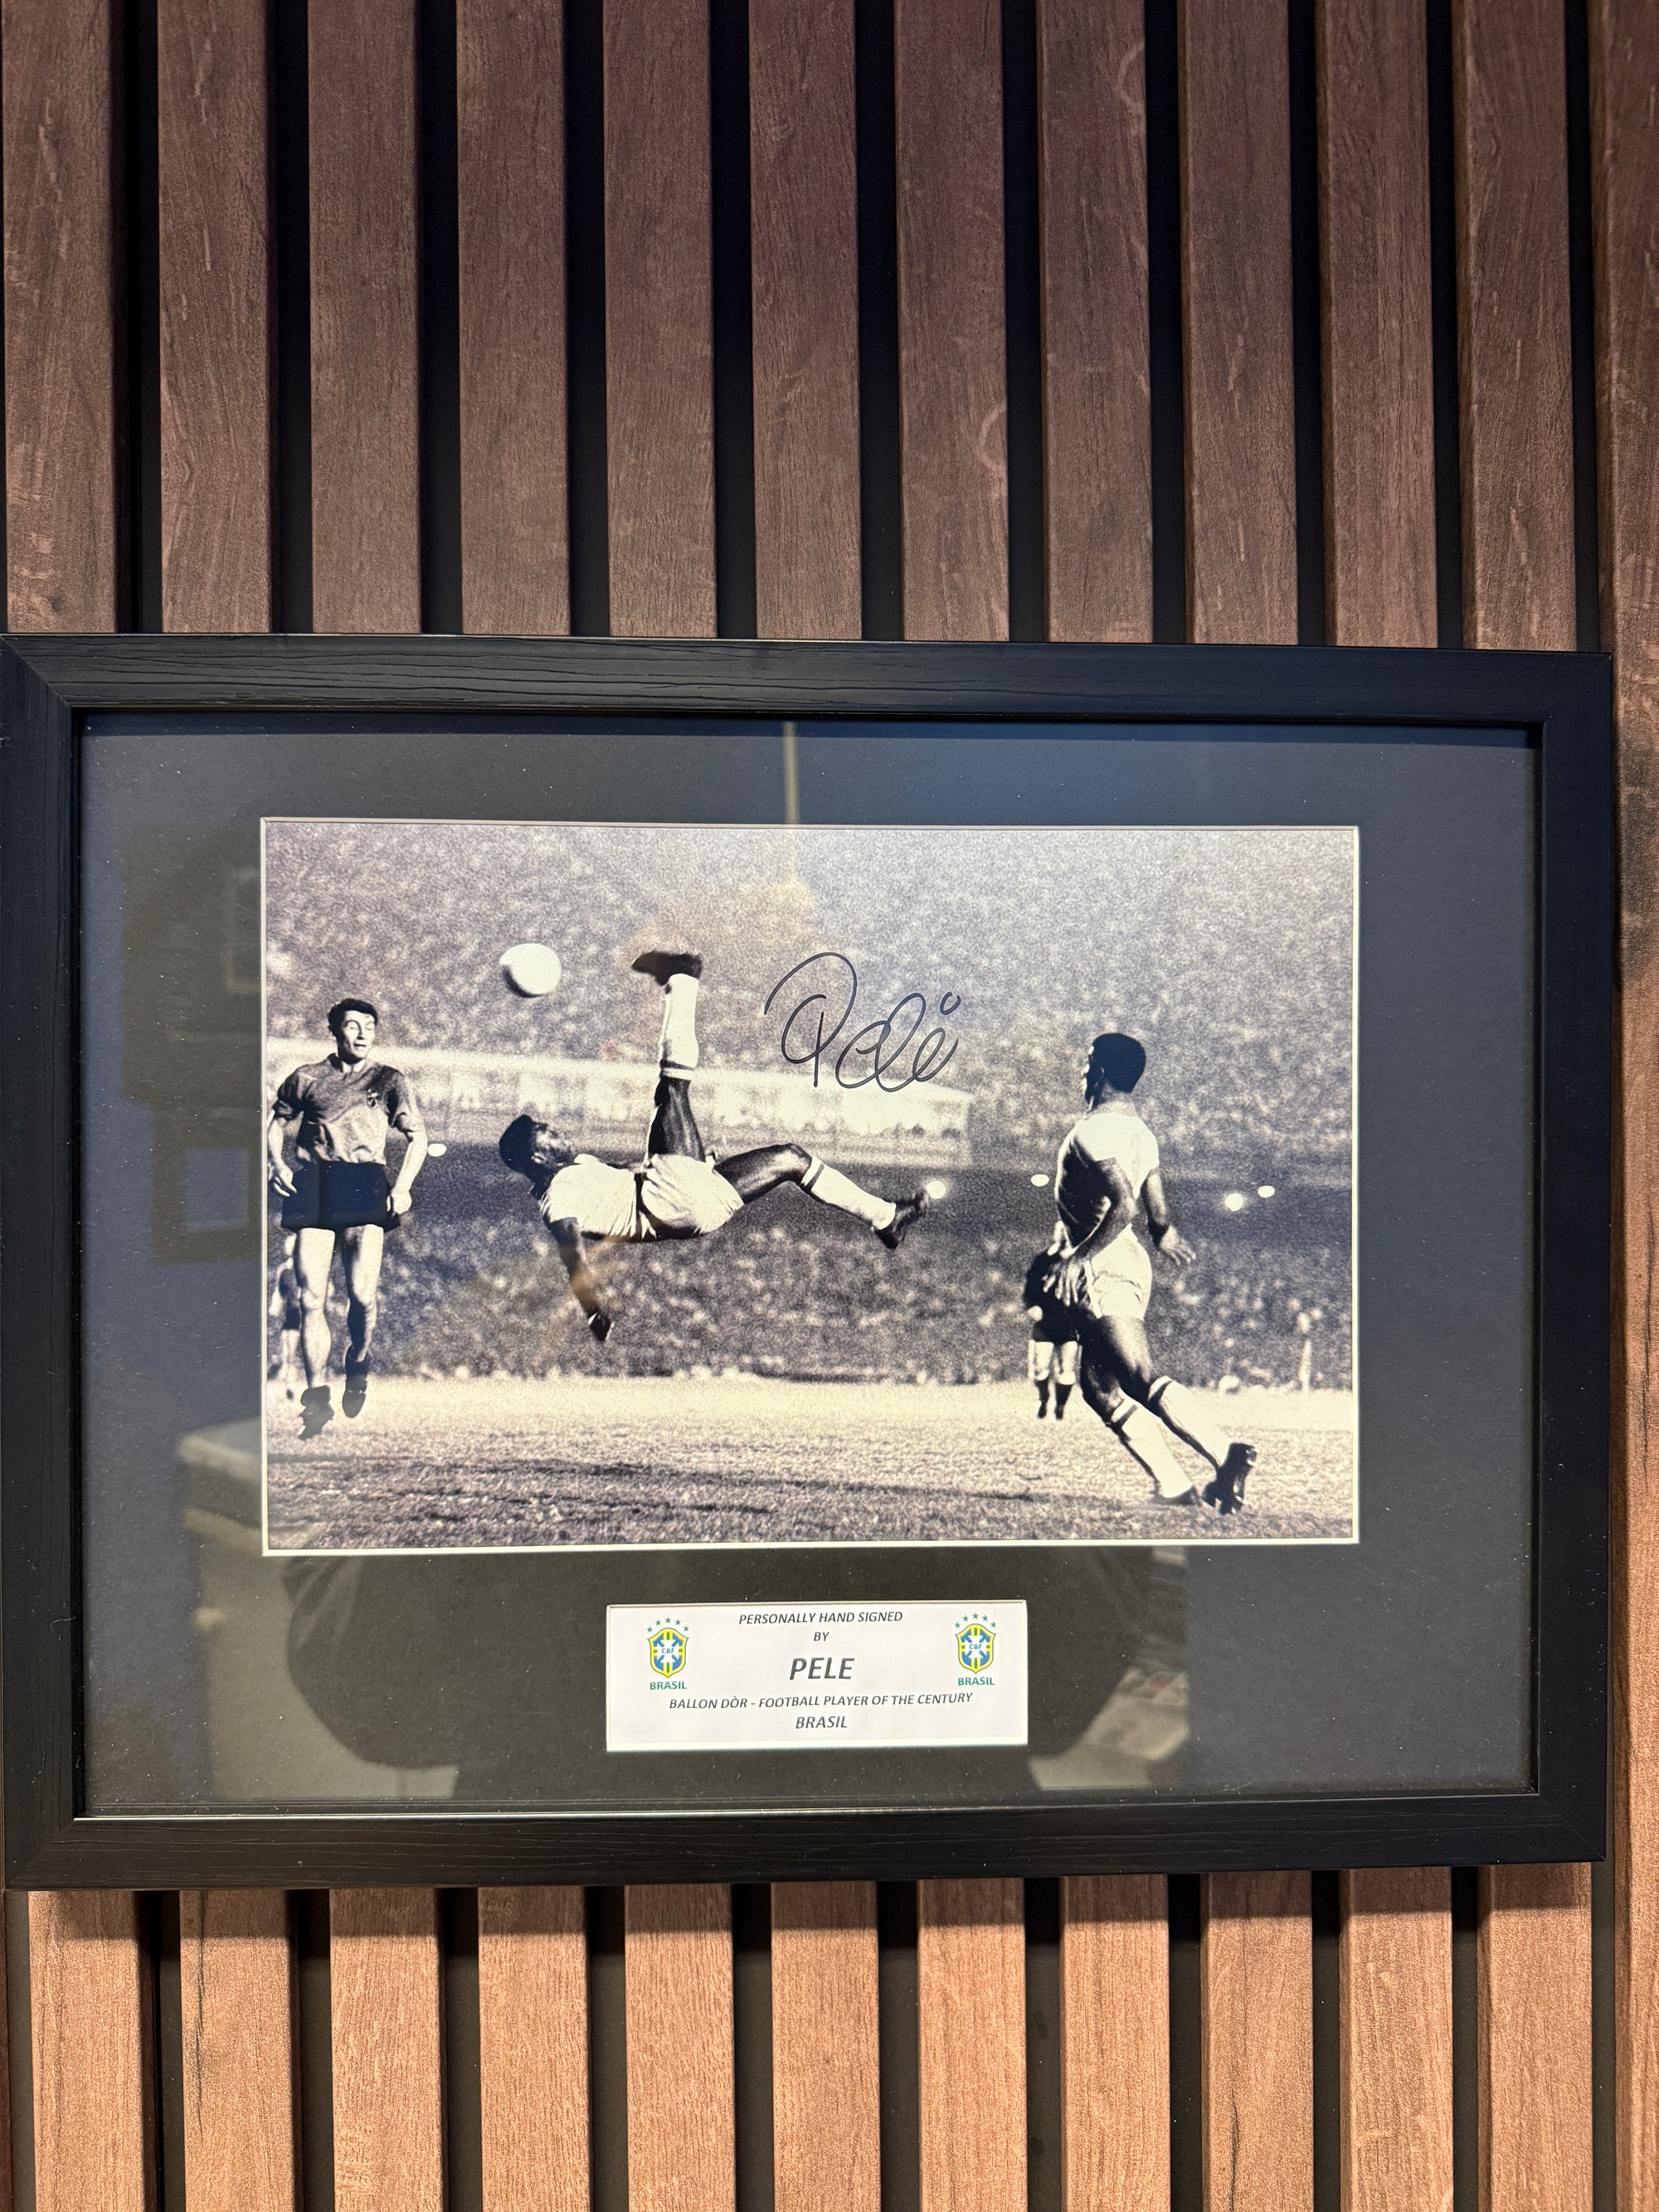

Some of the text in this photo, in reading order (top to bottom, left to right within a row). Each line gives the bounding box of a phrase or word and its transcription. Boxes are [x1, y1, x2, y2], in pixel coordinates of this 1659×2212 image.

[738, 1611, 903, 1625] PERSONALLY HAND SIGNED
[813, 1631, 830, 1642] BY
[789, 1656, 855, 1680] PELE
[649, 1680, 688, 1690] BRASIL
[957, 1676, 995, 1686] BRASIL
[669, 1698, 718, 1709] BALLON
[758, 1695, 820, 1708] FOOTBALL
[823, 1694, 869, 1706] PLAYER
[871, 1694, 889, 1705] OF
[891, 1694, 915, 1705] THE
[917, 1692, 974, 1705] CENTURY
[795, 1715, 849, 1729] BRASIL
